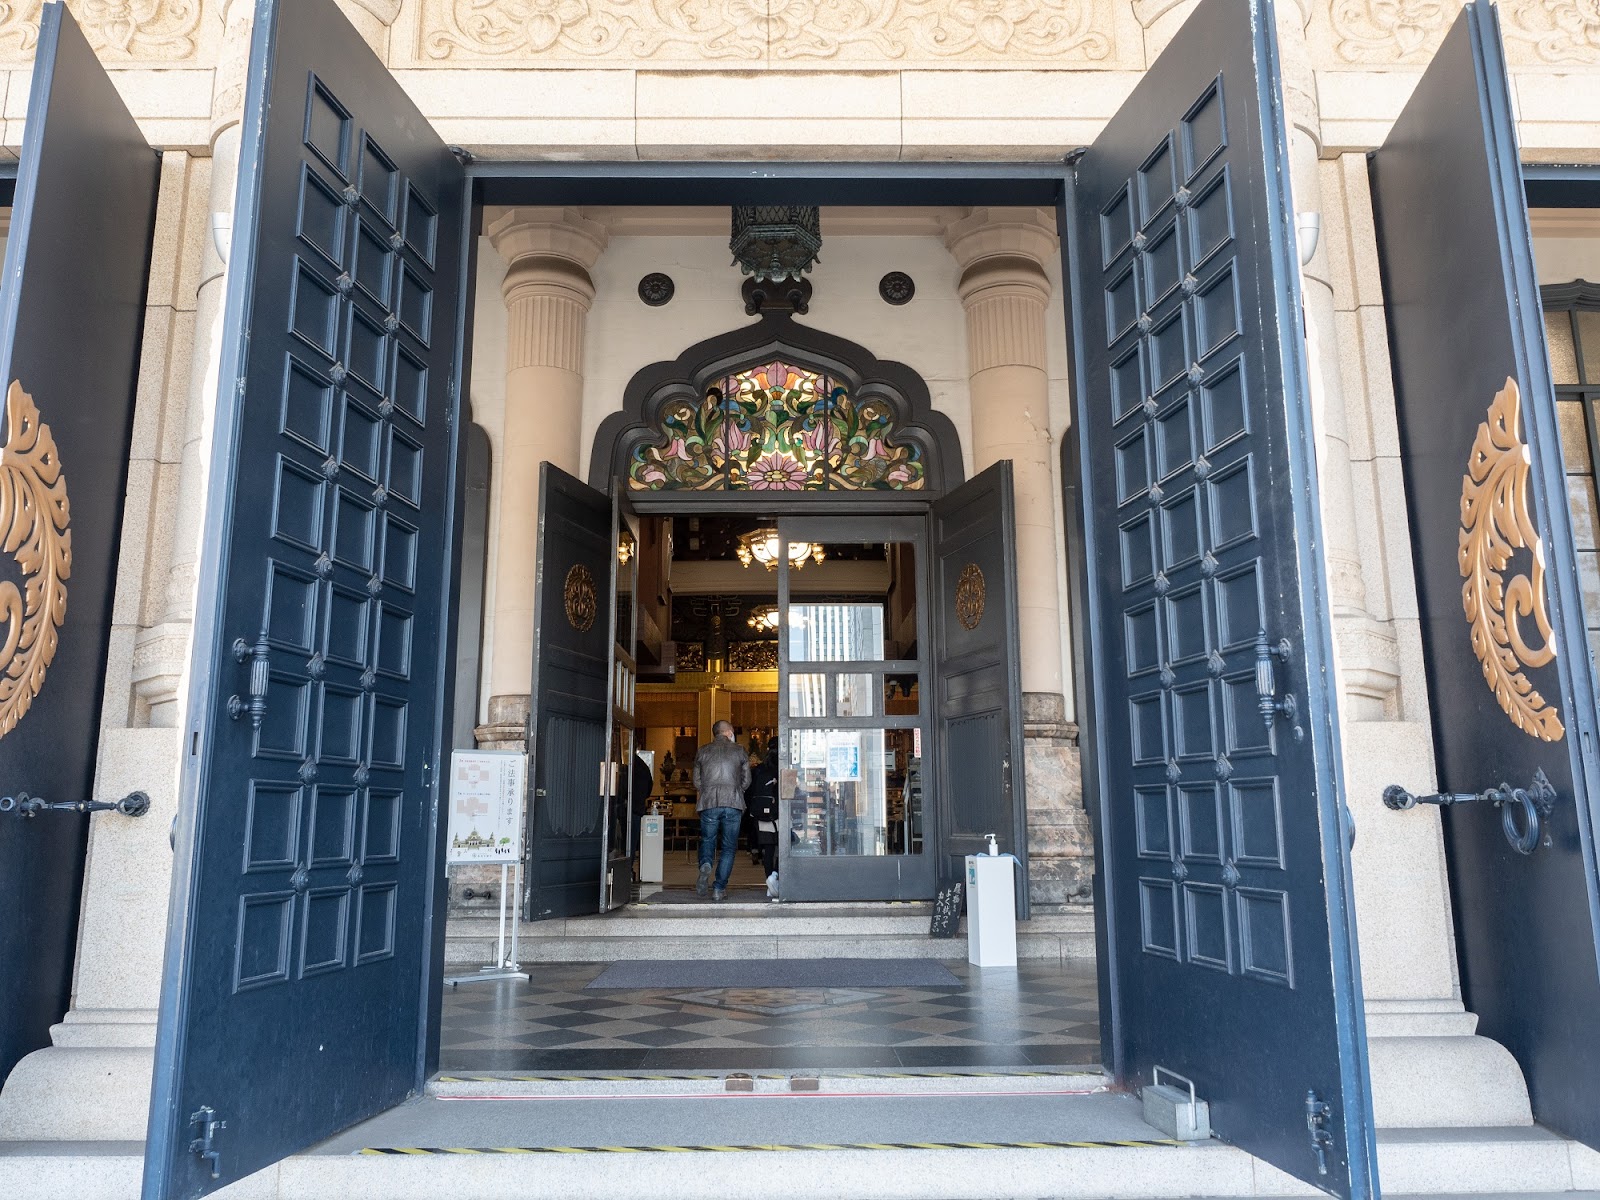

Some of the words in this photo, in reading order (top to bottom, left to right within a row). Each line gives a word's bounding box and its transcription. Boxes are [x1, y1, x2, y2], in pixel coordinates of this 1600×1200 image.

[505, 759, 517, 825] ご法事承ります
[931, 891, 945, 932] お入り下さい
[941, 888, 952, 928] よく拭って
